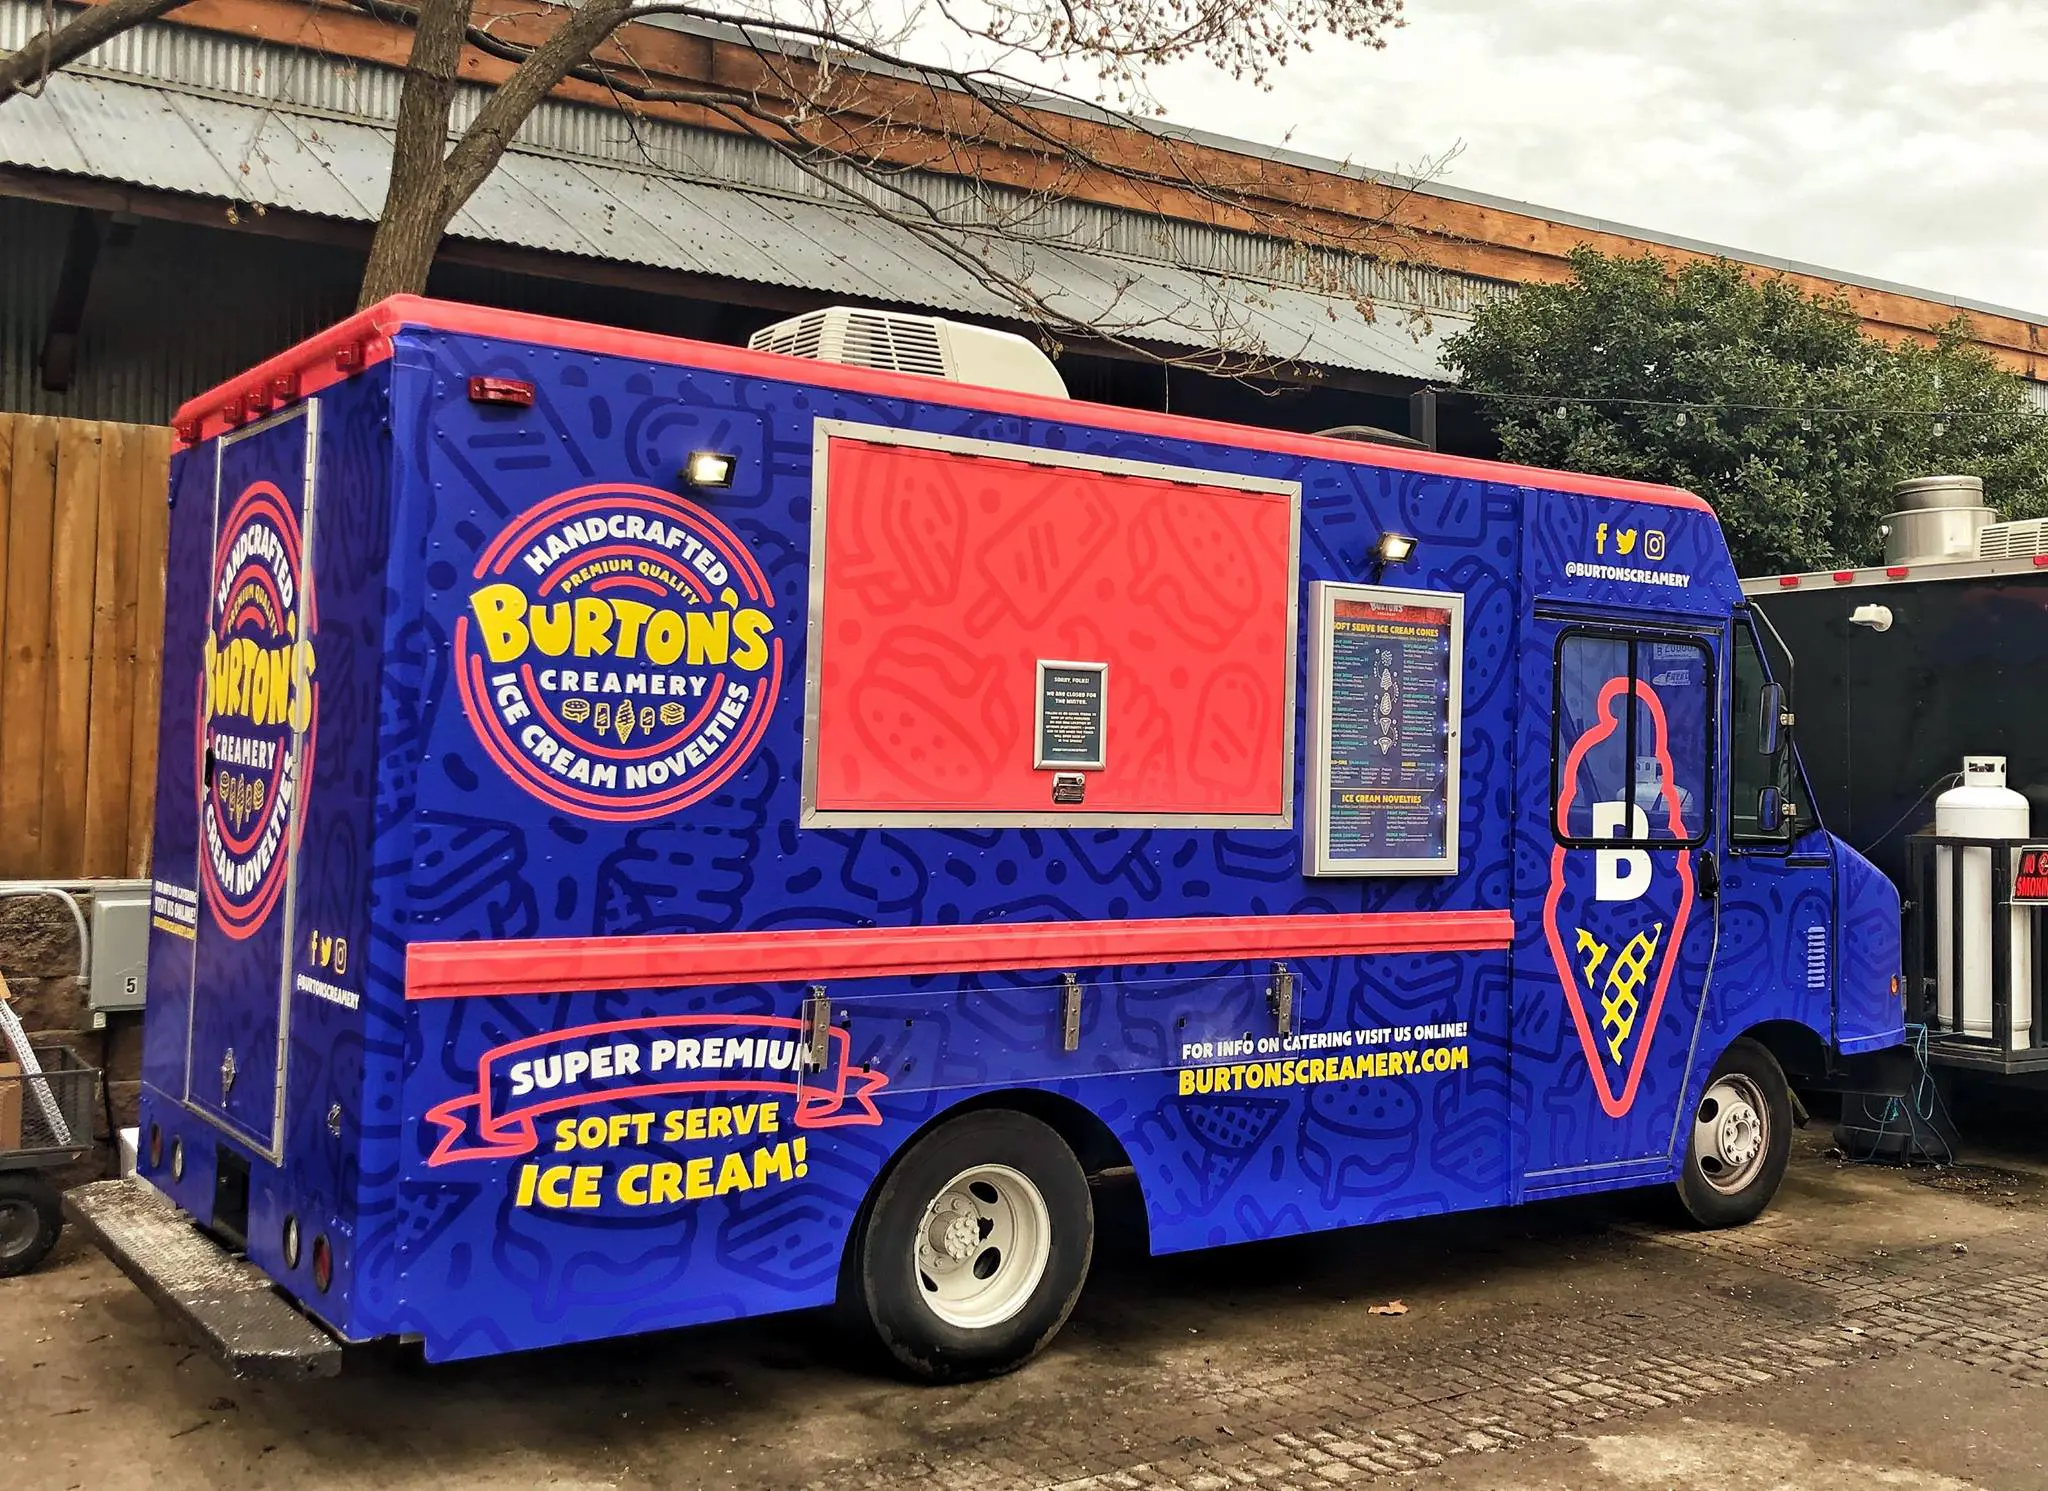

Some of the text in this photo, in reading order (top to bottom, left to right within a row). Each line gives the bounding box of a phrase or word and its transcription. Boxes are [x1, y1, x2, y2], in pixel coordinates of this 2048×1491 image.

[218, 524, 293, 614] HANDCRAFTED
[523, 515, 728, 586] HANDCRAFTED
[1565, 562, 1690, 588] @BURTONSCREAMERY
[561, 559, 699, 606] PREMIUM QUALITY
[469, 583, 774, 671] BURTON'S
[1352, 623, 1376, 633] SERVE
[1377, 625, 1389, 634] ICE
[1390, 626, 1415, 635] CREAM
[1416, 628, 1439, 637] CONES
[540, 670, 707, 697] CREAMERY
[215, 734, 276, 770] CREAMERY
[492, 673, 750, 789] ICE CREAM NOVELTIES
[1342, 794, 1422, 804] ICE CREAM NOVELTIES
[207, 804, 235, 892] CREAM
[1592, 801, 1653, 901] B
[2023, 853, 2035, 873] NO
[126, 978, 136, 993] 5
[1182, 1021, 1468, 1060] FOR INFO ON CATERING VISIT US ONLINE!
[510, 1043, 641, 1097] SUPER
[1178, 1045, 1469, 1097] BURTONSCREAMERY.COM
[554, 1102, 781, 1154] SOFT SERVE
[515, 1137, 808, 1208] ICE CREAM!
